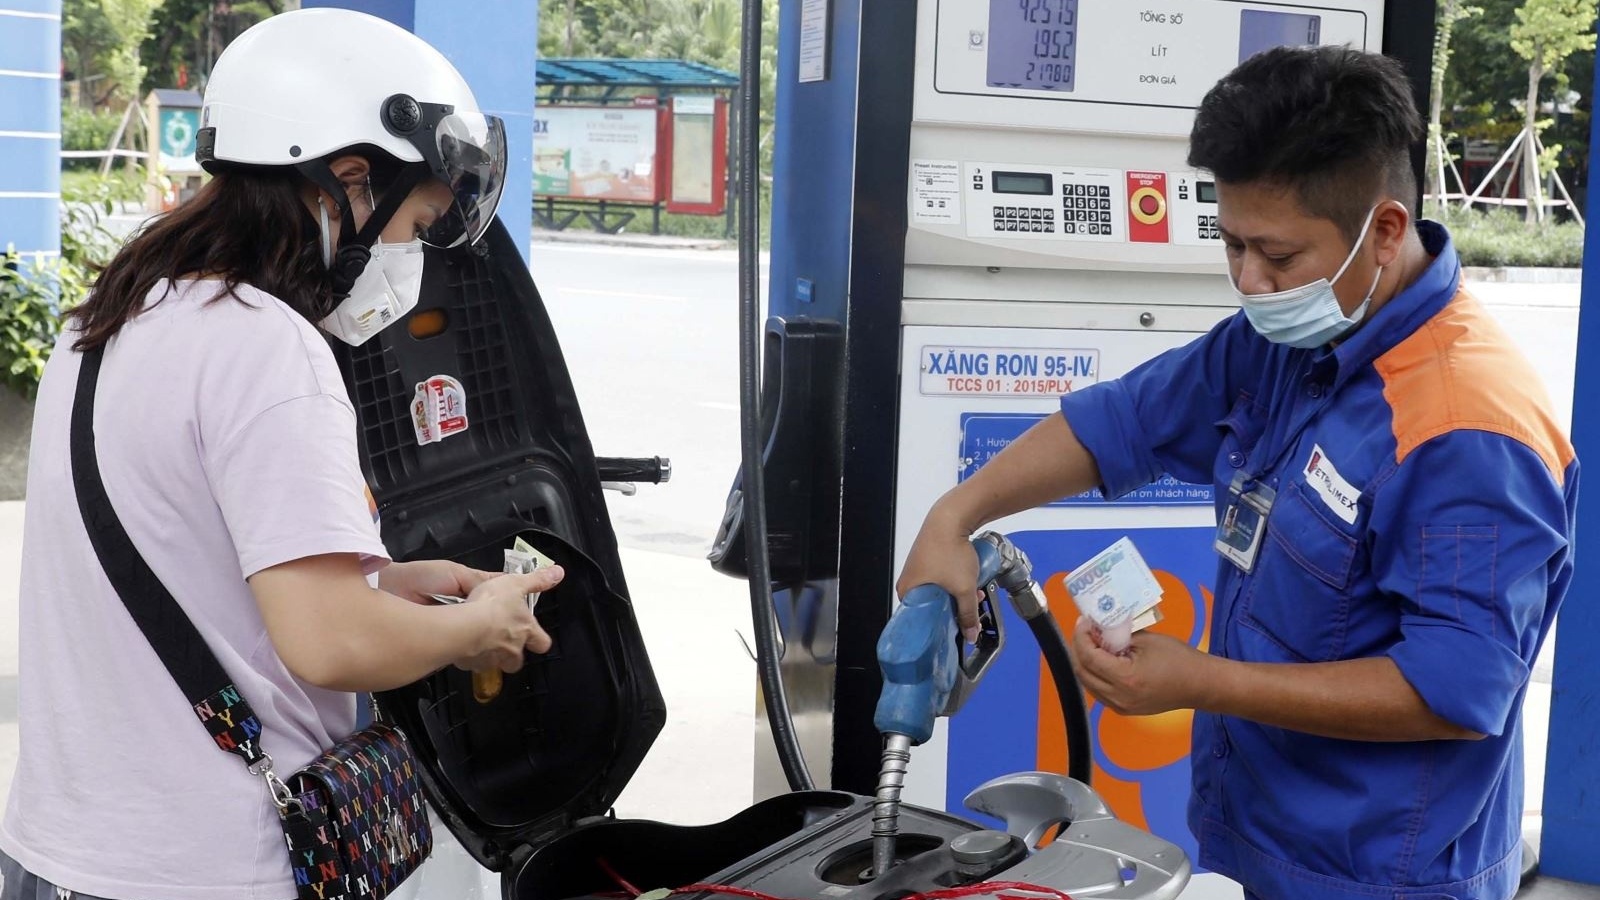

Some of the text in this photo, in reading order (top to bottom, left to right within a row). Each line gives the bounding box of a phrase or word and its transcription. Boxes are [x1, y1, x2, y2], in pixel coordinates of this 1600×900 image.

[1140, 10, 1184, 24] TỔNG SỐ
[1307, 18, 1317, 44] 0
[1151, 44, 1168, 57] LÍT
[1026, 62, 1071, 83] 21780
[1139, 75, 1177, 85] ĐƠN GIÁ
[928, 349, 1093, 377] XĂNG RON 95-IV
[947, 378, 982, 392] TCCS
[986, 379, 1001, 392] 01
[1013, 380, 1072, 393] 2015/PLX
[976, 438, 984, 447] 1.
[974, 451, 983, 460] 2.
[1155, 489, 1183, 498] khách
